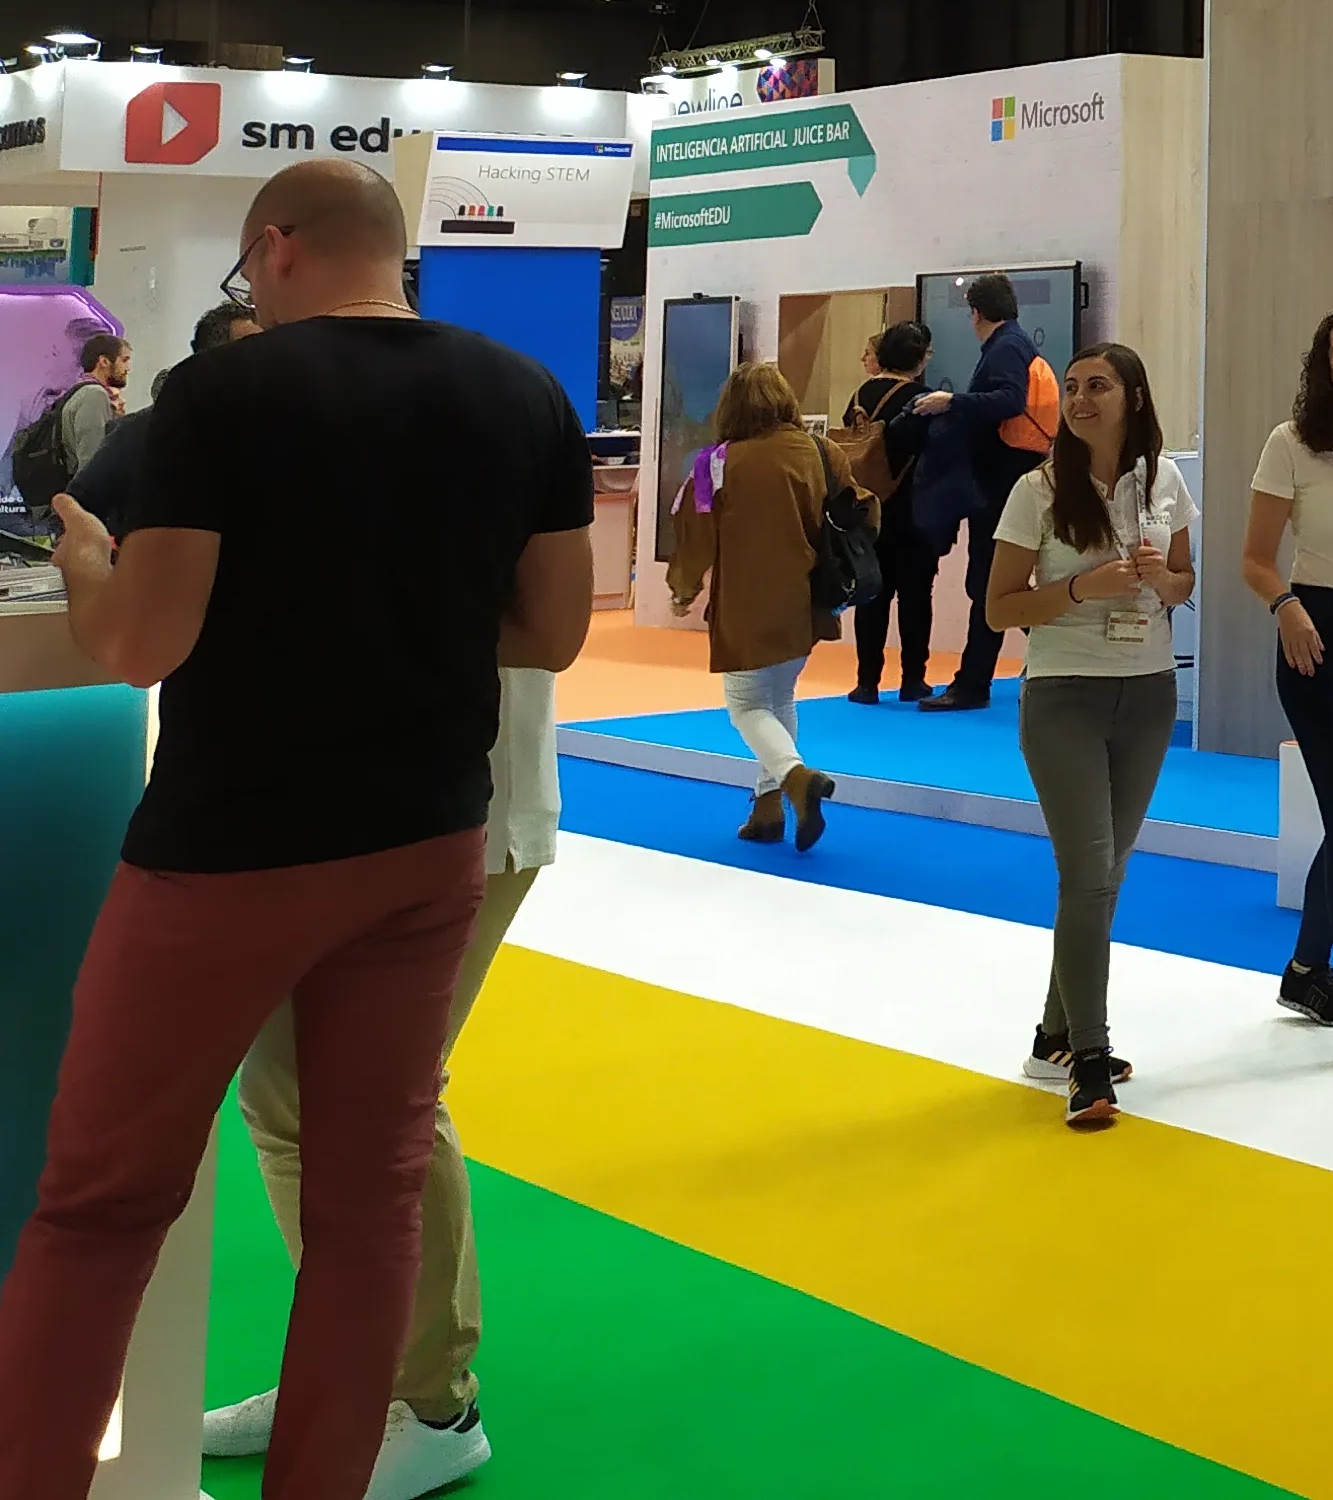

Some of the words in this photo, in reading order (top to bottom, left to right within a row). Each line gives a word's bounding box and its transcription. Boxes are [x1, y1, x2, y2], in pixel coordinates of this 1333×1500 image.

[1021, 92, 1105, 131] Microsoft
[241, 120, 314, 150] sm
[656, 136, 728, 163] INTELIGENCIA
[730, 129, 787, 154] ARTIFICIAL
[792, 124, 824, 146] JUICE
[827, 121, 850, 141] BAR
[478, 165, 541, 183] Hacking
[546, 167, 591, 182] STEM
[654, 206, 731, 230] #MicrosoftEDU
